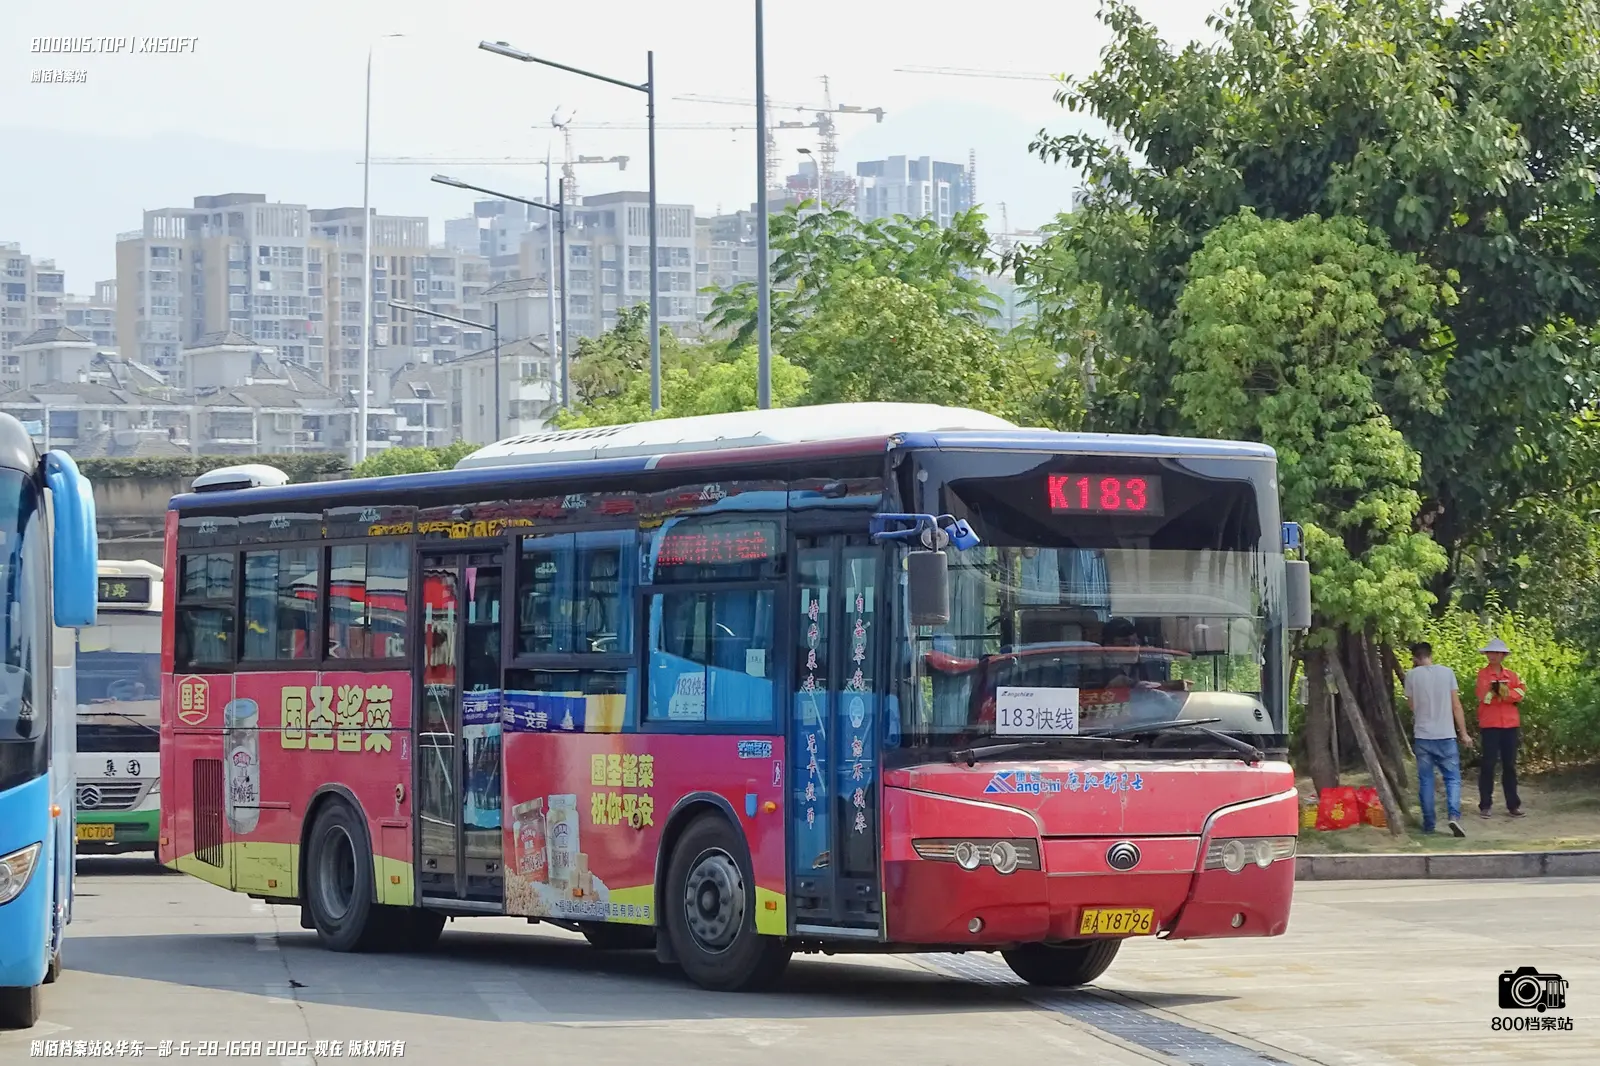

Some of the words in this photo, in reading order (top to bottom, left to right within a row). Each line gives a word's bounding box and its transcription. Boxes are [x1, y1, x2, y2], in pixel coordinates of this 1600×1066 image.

[1049, 476, 1146, 510] K183
[281, 684, 393, 753] 国圣酱菜
[1001, 707, 1074, 730] 183快线
[591, 754, 653, 788] 国圣酱菜
[591, 791, 653, 827] 祝你平安
